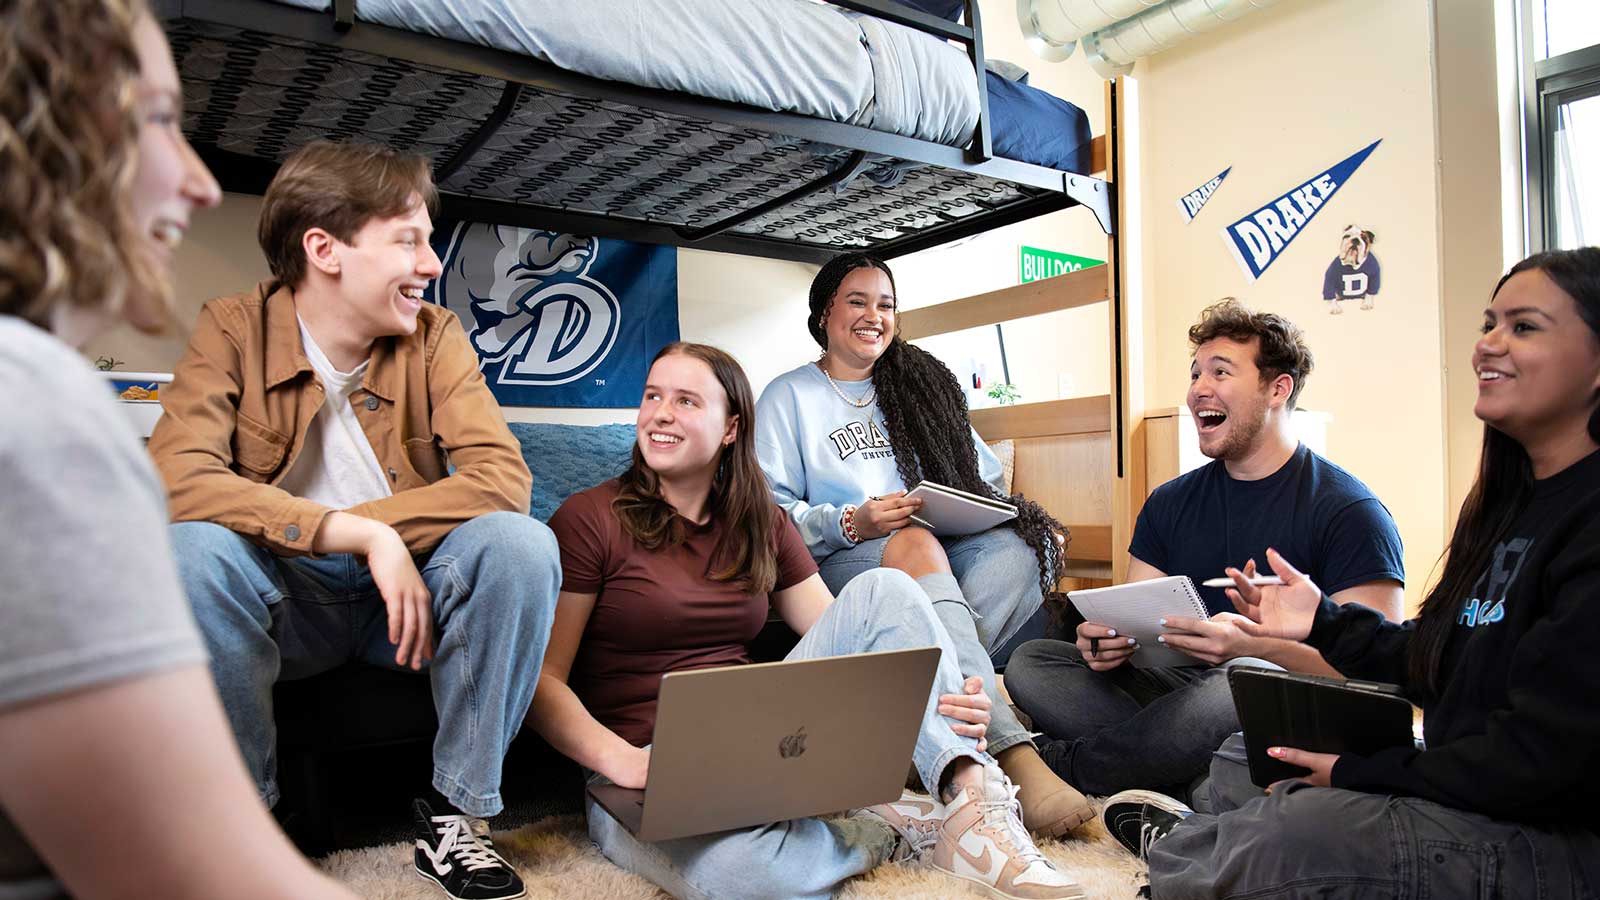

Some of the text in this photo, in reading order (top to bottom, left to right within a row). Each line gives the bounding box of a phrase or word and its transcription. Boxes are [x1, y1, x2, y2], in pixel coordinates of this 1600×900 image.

[1183, 177, 1223, 217] DRAKE
[1234, 173, 1337, 271] DRAKE
[1342, 273, 1369, 295] D
[500, 279, 620, 384] D
[829, 421, 890, 460] DRA
[861, 451, 893, 460] UNIVE
